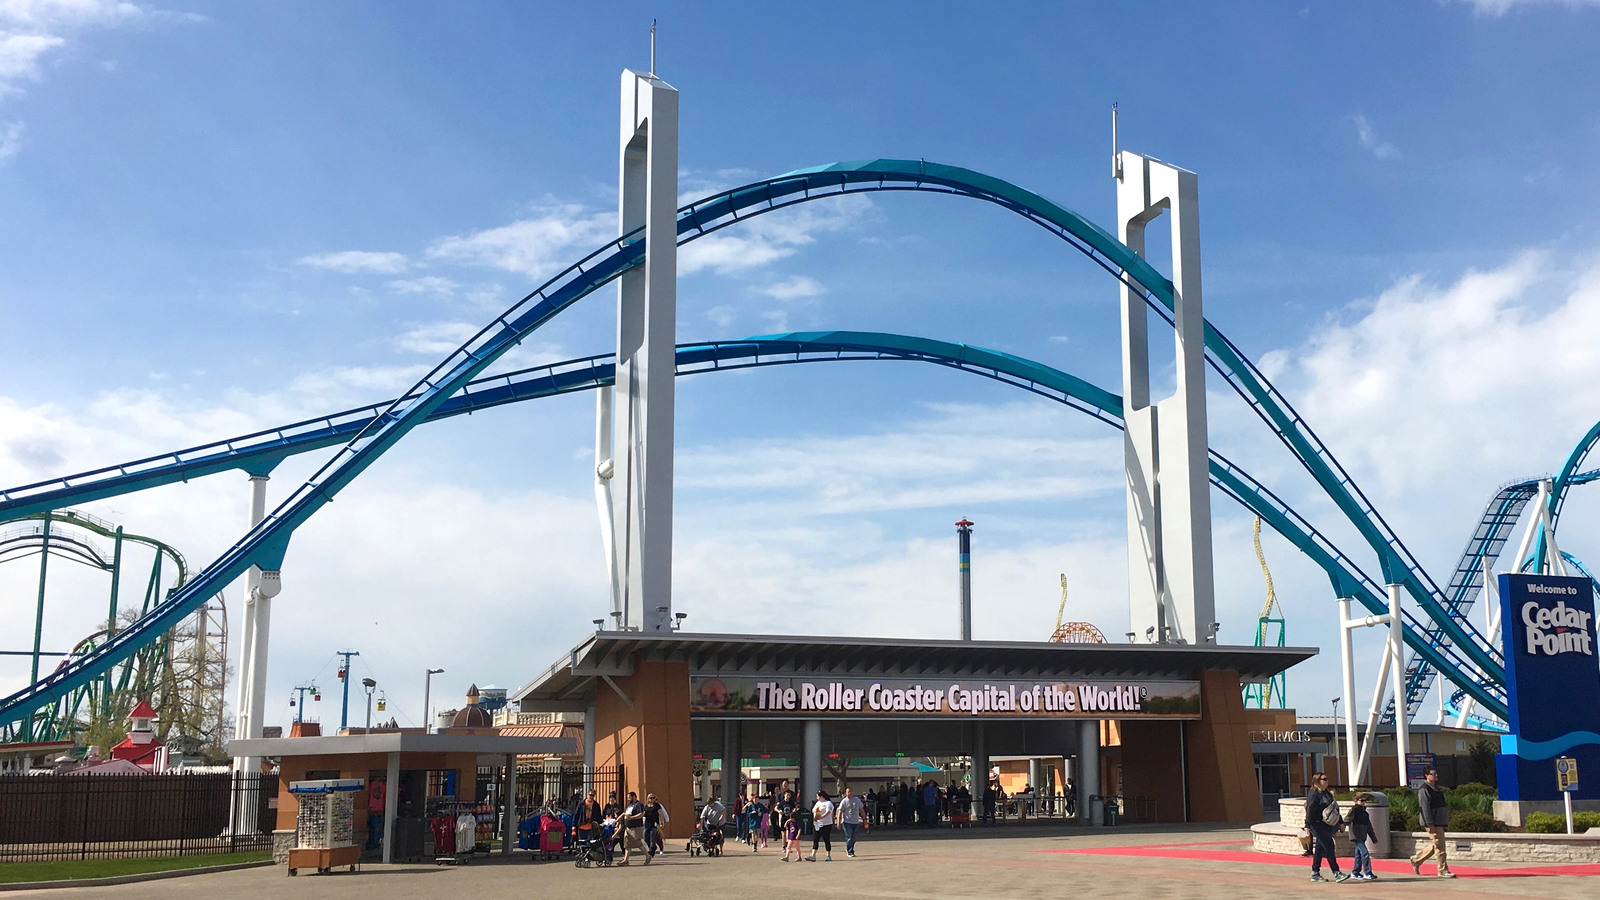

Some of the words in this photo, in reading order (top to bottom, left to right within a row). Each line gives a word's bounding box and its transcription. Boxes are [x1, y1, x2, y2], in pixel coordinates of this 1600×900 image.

[1527, 583, 1567, 595] Welcome
[1567, 586, 1578, 595] to
[1521, 601, 1592, 630] Cedar
[1526, 627, 1593, 656] Point
[757, 682, 796, 710] The
[801, 683, 865, 711] Roller
[868, 683, 945, 712] Coaster
[948, 684, 1016, 715] Capital
[1019, 684, 1041, 712] of
[1044, 685, 1076, 712] the
